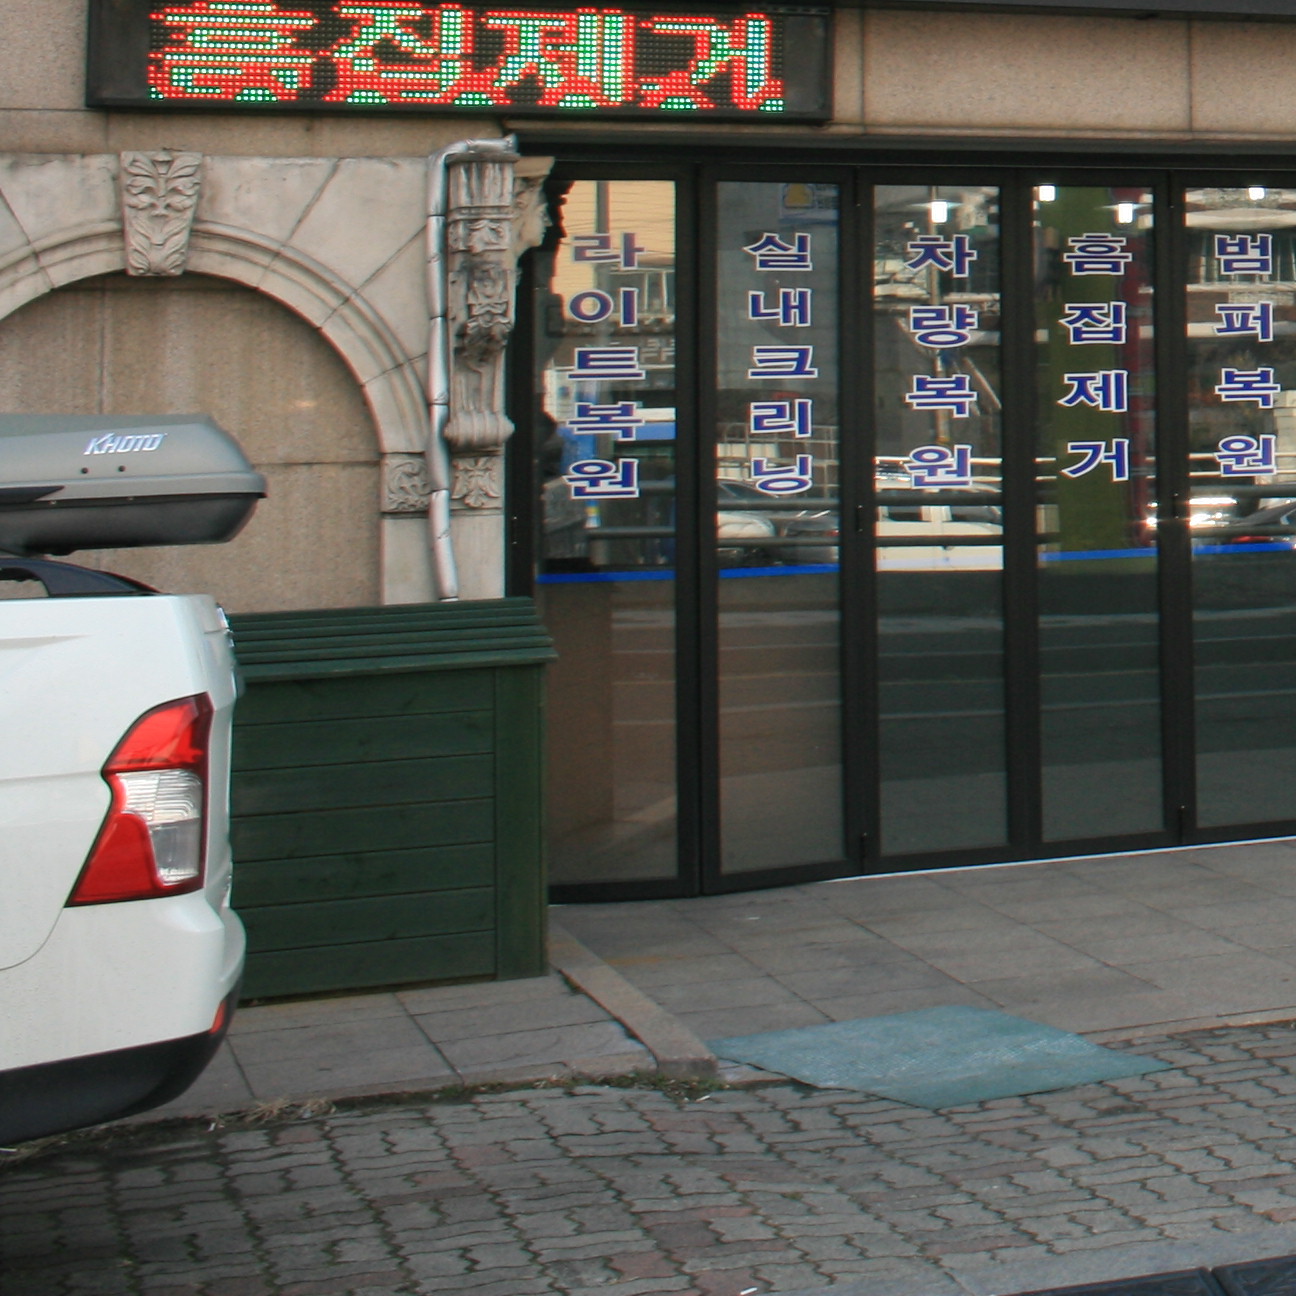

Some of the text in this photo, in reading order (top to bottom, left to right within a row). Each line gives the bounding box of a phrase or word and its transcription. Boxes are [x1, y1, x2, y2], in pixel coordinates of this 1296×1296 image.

[561, 232, 647, 499] 라이트복원
[742, 232, 819, 496] 실내크리닝
[904, 234, 978, 491] 차량복원
[1057, 233, 1133, 483] 흠집제거
[1214, 233, 1282, 477] 범퍼복원
